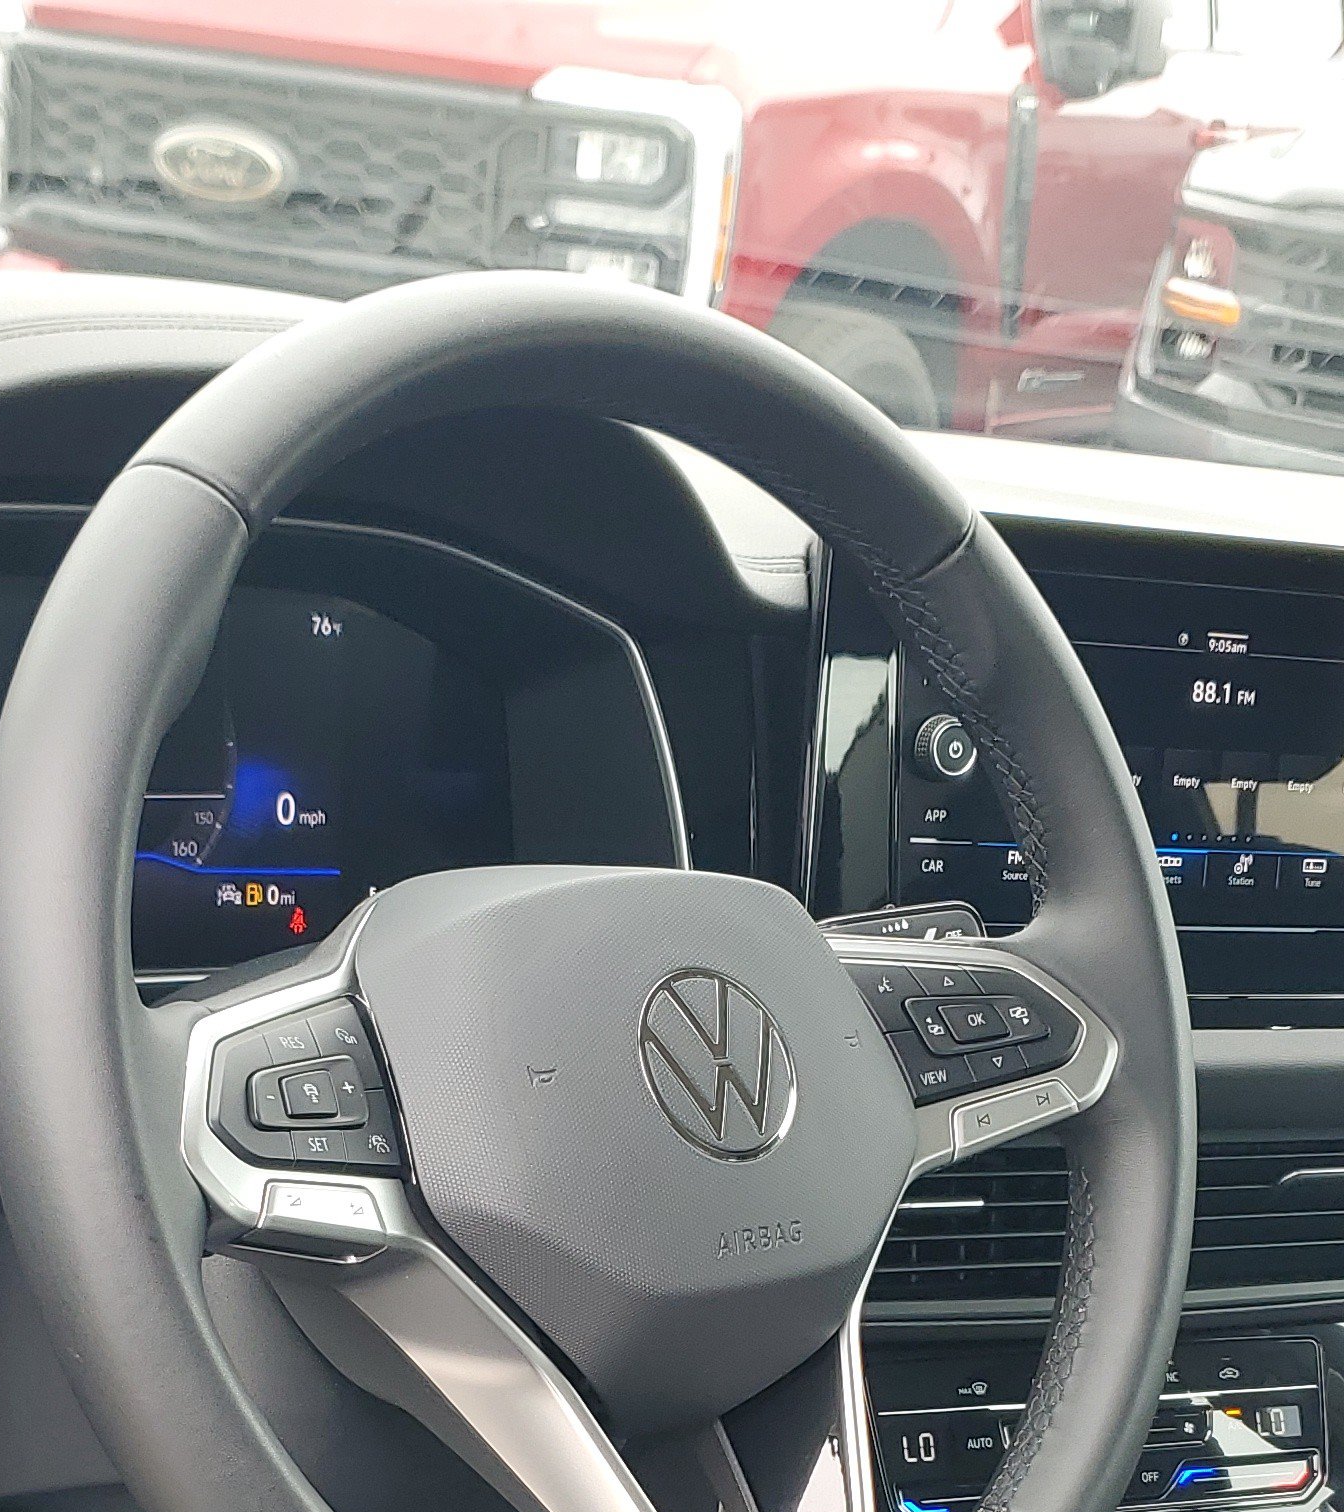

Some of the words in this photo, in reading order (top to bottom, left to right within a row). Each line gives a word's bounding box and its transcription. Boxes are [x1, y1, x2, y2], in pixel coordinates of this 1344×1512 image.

[1208, 639, 1248, 655] 9:05am
[1192, 680, 1232, 704] 88.1
[1237, 691, 1256, 706] FM
[1173, 774, 1201, 789] Empty
[1231, 777, 1258, 791] Empty
[1287, 780, 1314, 794] Empty
[276, 791, 296, 826] 0
[299, 810, 326, 828] mph
[925, 809, 948, 823] APP
[194, 811, 214, 826] 150
[172, 841, 198, 857] 160
[921, 859, 944, 873] CAR
[1002, 870, 1029, 881] Source
[1162, 874, 1183, 886] sets
[1228, 876, 1254, 887] Station
[1305, 878, 1321, 888] Tune
[967, 1013, 986, 1027] OK
[280, 1036, 305, 1050] RES
[919, 1070, 948, 1086] VIEW
[308, 1137, 329, 1152] SET
[716, 1219, 804, 1260] AIRBAG
[967, 1437, 993, 1450] AUTO
[1141, 1472, 1159, 1483] OFF
